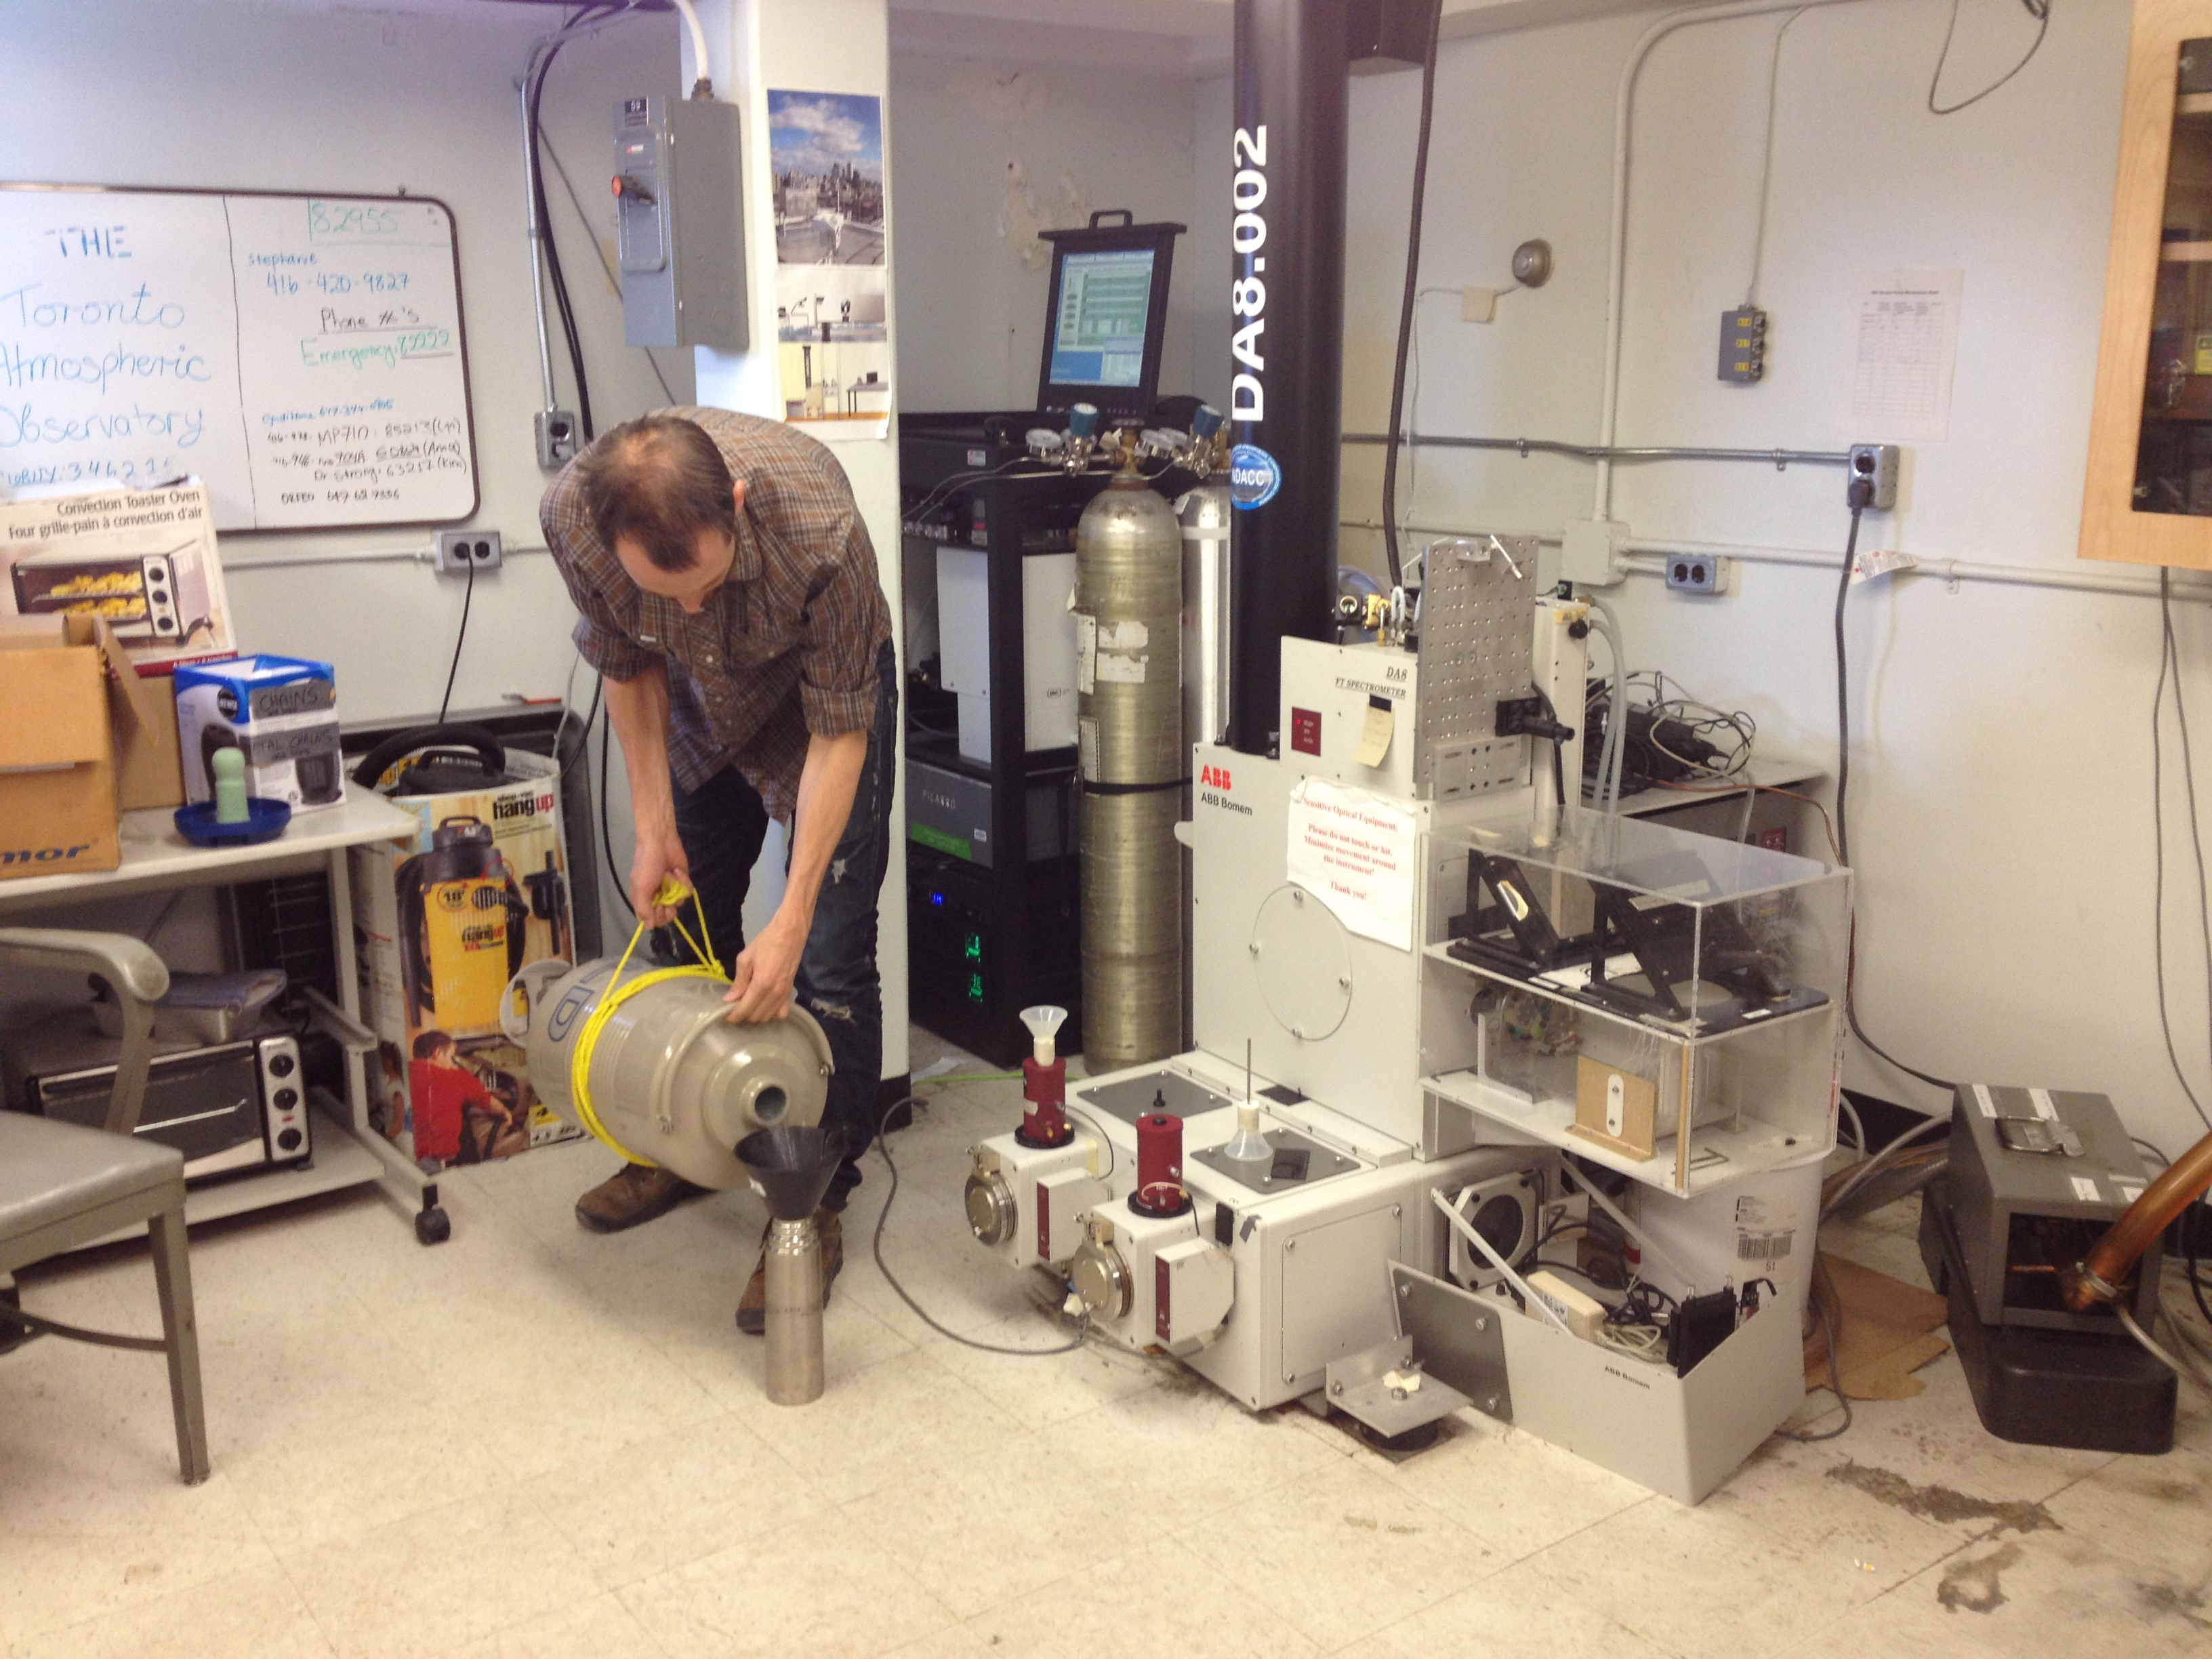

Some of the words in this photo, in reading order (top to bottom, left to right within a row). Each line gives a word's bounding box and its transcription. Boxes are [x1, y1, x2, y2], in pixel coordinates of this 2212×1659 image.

[44, 224, 132, 258] THE
[1232, 125, 1267, 422] DA8.002
[0, 281, 186, 329] Toronto
[321, 306, 369, 332] Phone
[57, 497, 122, 517] Convection
[125, 491, 166, 510] Toaster
[169, 489, 200, 504] Oven
[8, 524, 35, 540] Four
[39, 517, 100, 539] grille-pain
[102, 516, 110, 527] à
[112, 508, 174, 527] convection
[177, 506, 202, 520] d'air
[1385, 666, 1408, 680] DA8
[1335, 677, 1345, 686] FT
[1347, 679, 1406, 698] SPECTROMETER
[1201, 764, 1231, 792] ABB
[1201, 792, 1219, 806] ABB
[1221, 796, 1252, 816] Bomem
[1303, 797, 1332, 813] Sensitive
[1333, 805, 1357, 820] Optical
[1309, 823, 1328, 836] Please
[1330, 831, 1338, 839] do
[1339, 834, 1350, 844] not
[1351, 837, 1370, 850] touch
[1304, 835, 1334, 852] Minimize
[1336, 846, 1370, 863] movement
[1372, 856, 1397, 872] around
[1324, 855, 1334, 865] the
[1336, 857, 1374, 877] instrument!
[1330, 881, 1351, 896] Thank
[1353, 890, 1368, 901] you!
[1604, 1365, 1621, 1378] ABB
[1622, 1372, 1650, 1391] Bomem
